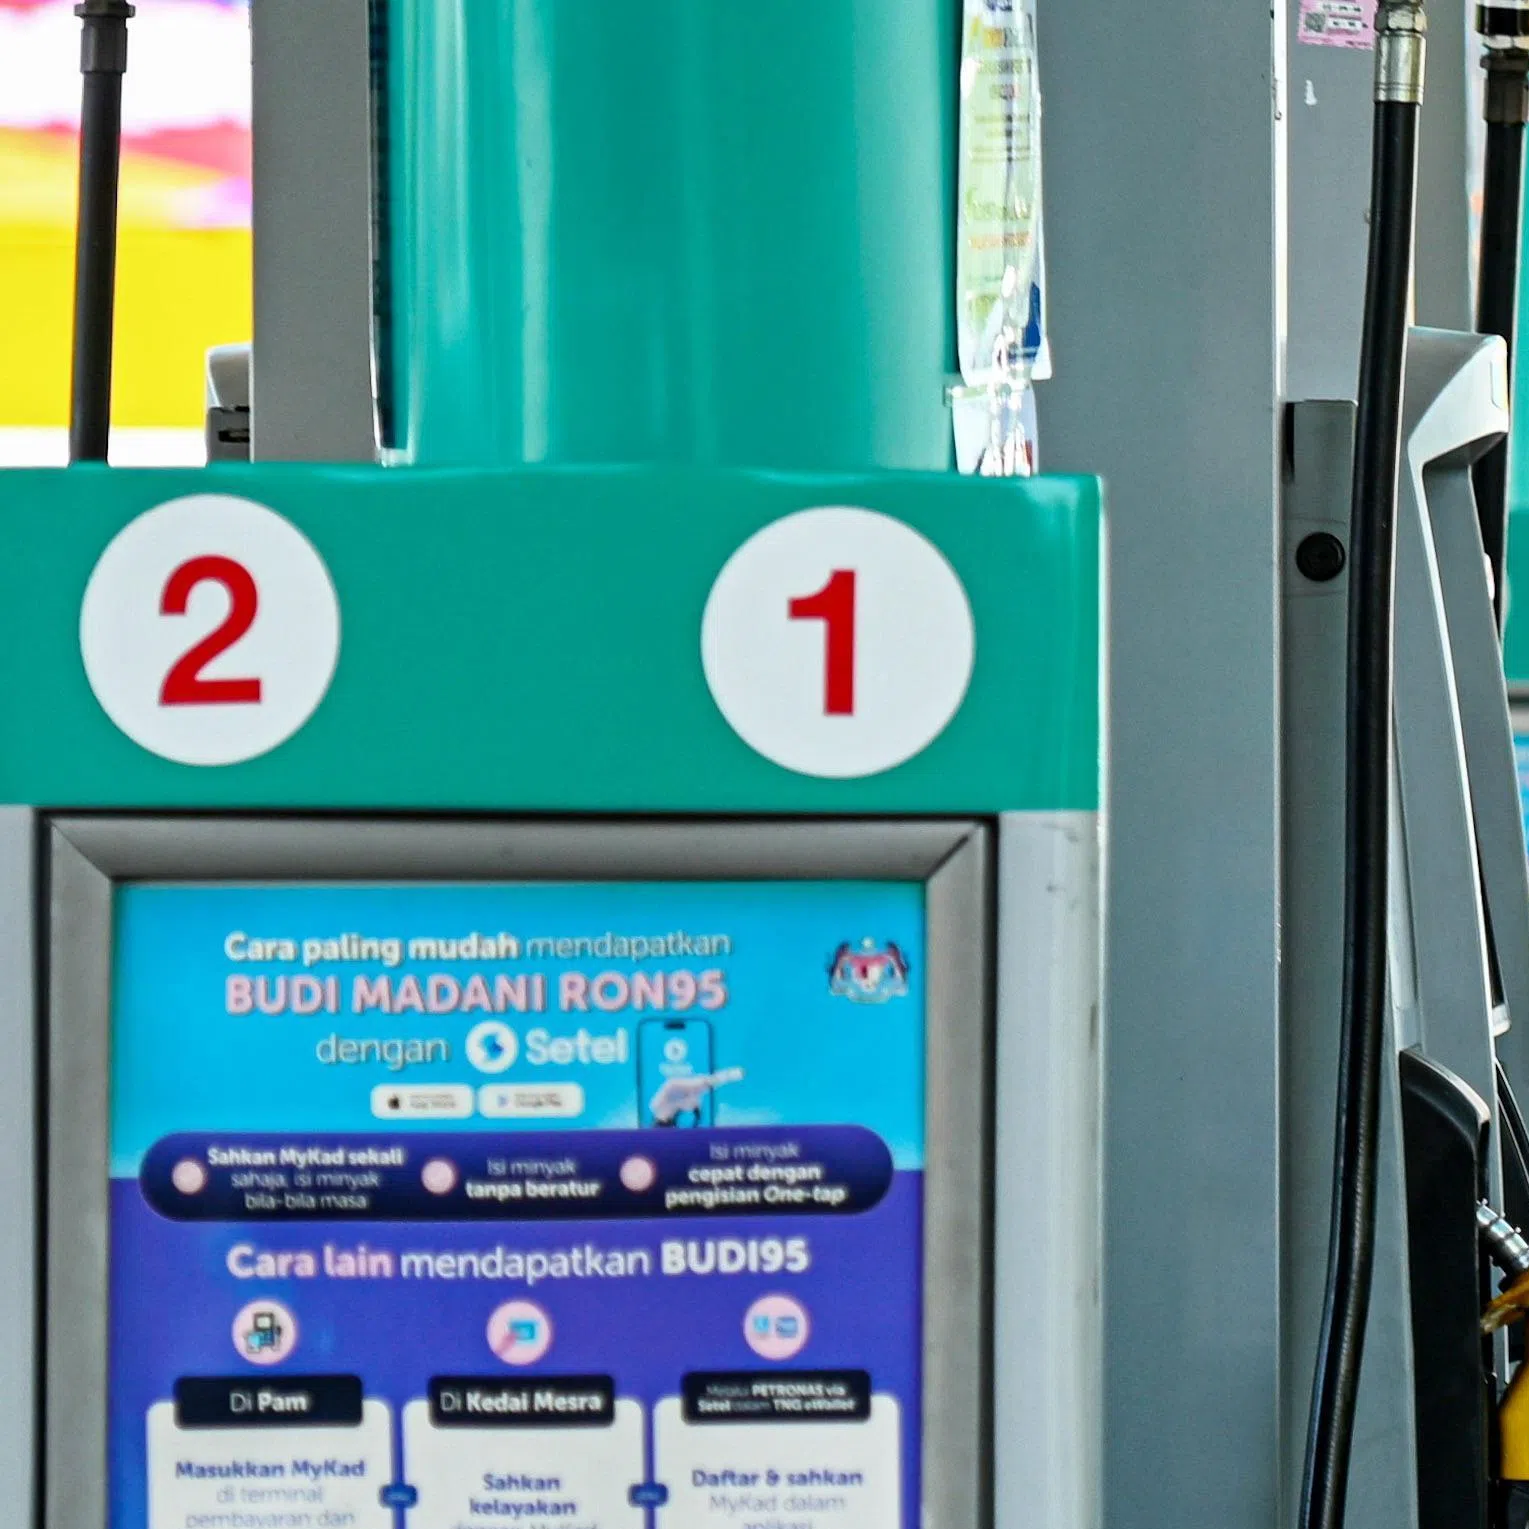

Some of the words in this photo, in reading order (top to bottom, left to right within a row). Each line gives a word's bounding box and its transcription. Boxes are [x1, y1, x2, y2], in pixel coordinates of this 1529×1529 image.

[157, 555, 262, 706] 2
[788, 569, 857, 715] 1
[224, 931, 297, 961] Cara
[303, 933, 402, 967] paling
[408, 932, 519, 960] mudah
[526, 930, 731, 962] mendapatkan
[225, 973, 341, 1014] BUDI
[352, 972, 546, 1013] MADANI
[559, 969, 728, 1012] RON95
[315, 1031, 448, 1069] dengan
[525, 1027, 630, 1065] Setel
[207, 1147, 275, 1166] Sahkan
[279, 1147, 345, 1169] MyKad
[348, 1147, 406, 1166] sekali
[688, 1165, 744, 1185] cepat
[747, 1164, 822, 1185] dengan
[244, 1193, 315, 1209] bila-bila
[320, 1194, 368, 1209] masa
[466, 1181, 522, 1201] tanpa
[525, 1180, 600, 1198] beratur
[665, 1187, 760, 1209] pengisian
[763, 1186, 846, 1206] One-tap
[226, 1245, 315, 1278] Cara
[323, 1244, 392, 1277] lain
[400, 1245, 650, 1286] mendapatkan
[661, 1238, 809, 1274] BUDI95
[752, 1384, 823, 1397] PETRONAS
[229, 1392, 252, 1412] Di
[257, 1392, 307, 1412] Pam
[440, 1392, 461, 1412] Di
[466, 1391, 527, 1412] Kedai
[533, 1391, 602, 1412] Mesra
[175, 1460, 285, 1478] Masukkan
[291, 1459, 365, 1479] MyKad
[692, 1468, 759, 1486] Daftar
[766, 1469, 780, 1486] &
[787, 1468, 863, 1486] sahkan
[484, 1473, 560, 1491] Sahkan
[217, 1486, 234, 1503] di
[240, 1486, 323, 1503] terminal
[784, 1494, 846, 1511] dalam
[317, 1510, 355, 1527] dan
[470, 1498, 576, 1520] kelayakan
